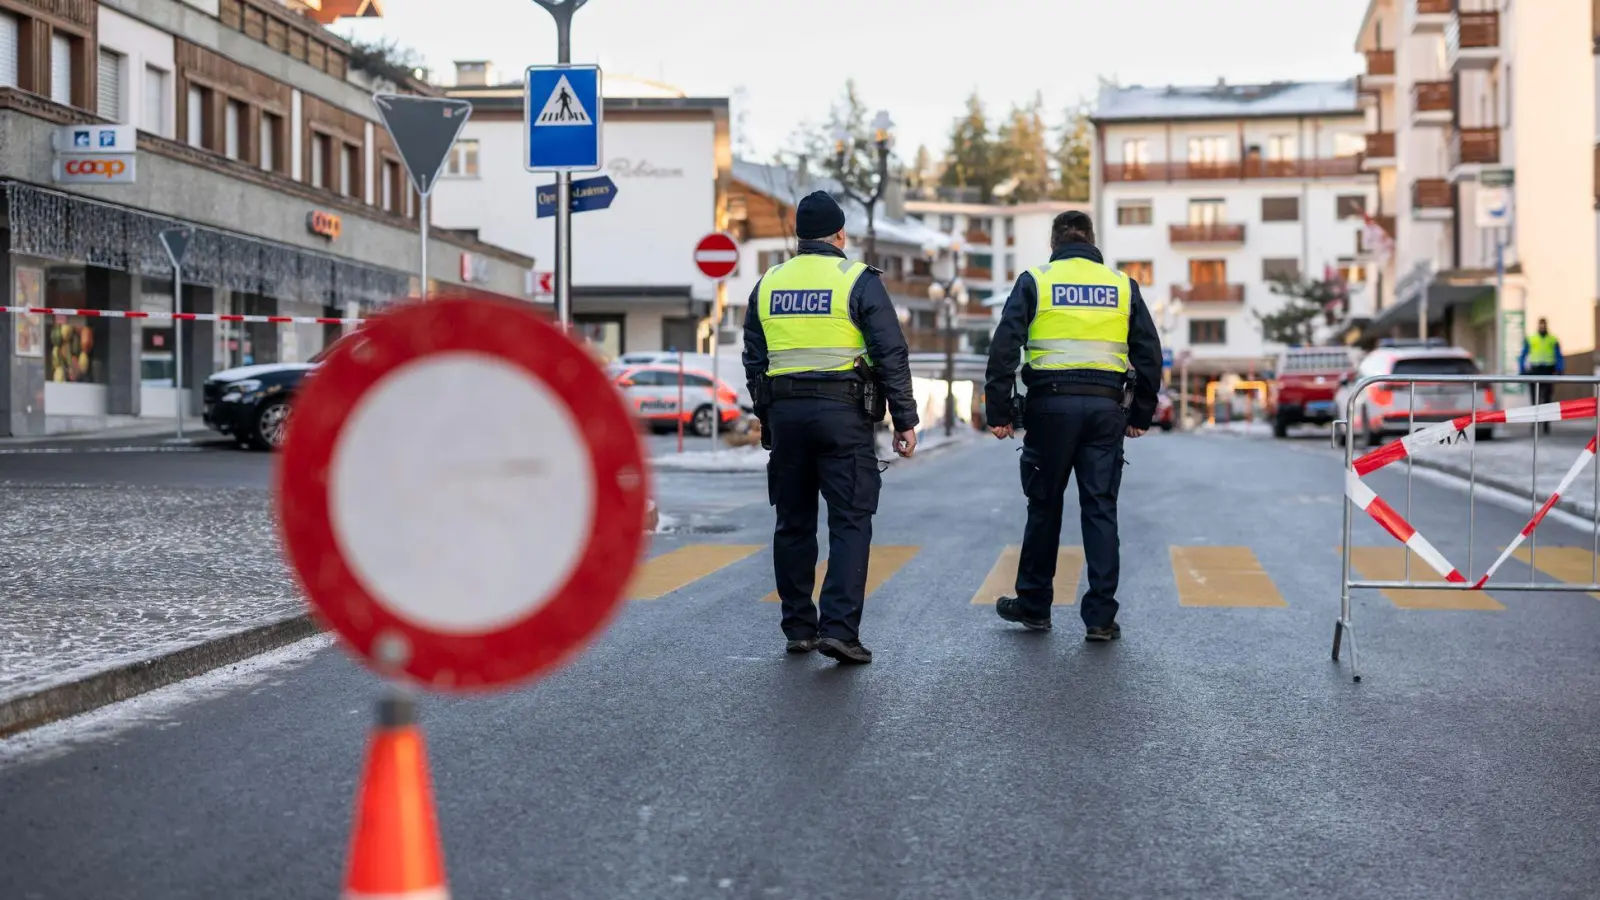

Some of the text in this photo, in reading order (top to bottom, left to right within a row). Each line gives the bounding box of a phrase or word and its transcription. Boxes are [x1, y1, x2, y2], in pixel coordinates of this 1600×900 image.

[65, 160, 126, 178] coop
[772, 292, 829, 312] POLICE
[1054, 286, 1116, 305] POLICE
